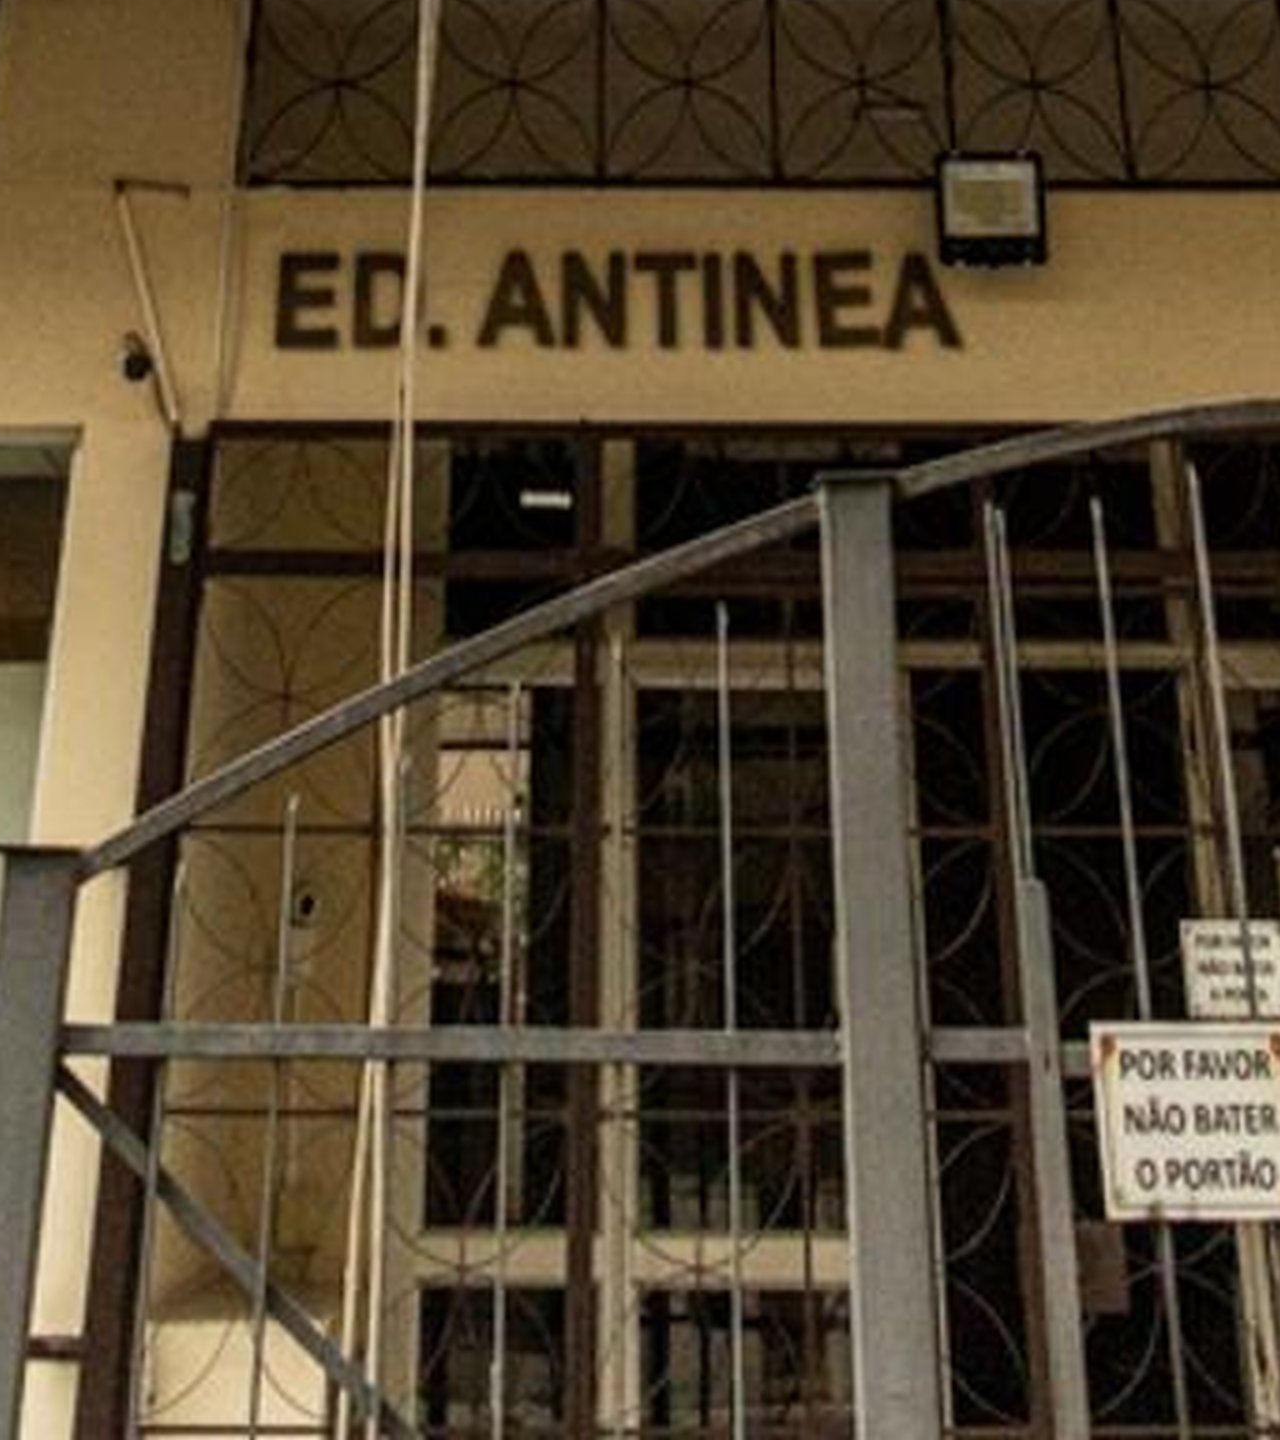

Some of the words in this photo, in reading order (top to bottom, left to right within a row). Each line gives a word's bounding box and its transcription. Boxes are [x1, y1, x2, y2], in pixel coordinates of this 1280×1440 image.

[273, 250, 446, 350] ED.
[477, 250, 962, 351] ANTINEA
[1120, 1050, 1177, 1080] POR
[1183, 1050, 1271, 1080] FAVOR
[1123, 1097, 1185, 1135] NÃO
[1193, 1104, 1279, 1136] BATER
[1135, 1158, 1158, 1192] O
[1164, 1150, 1276, 1190] PORTÃO
